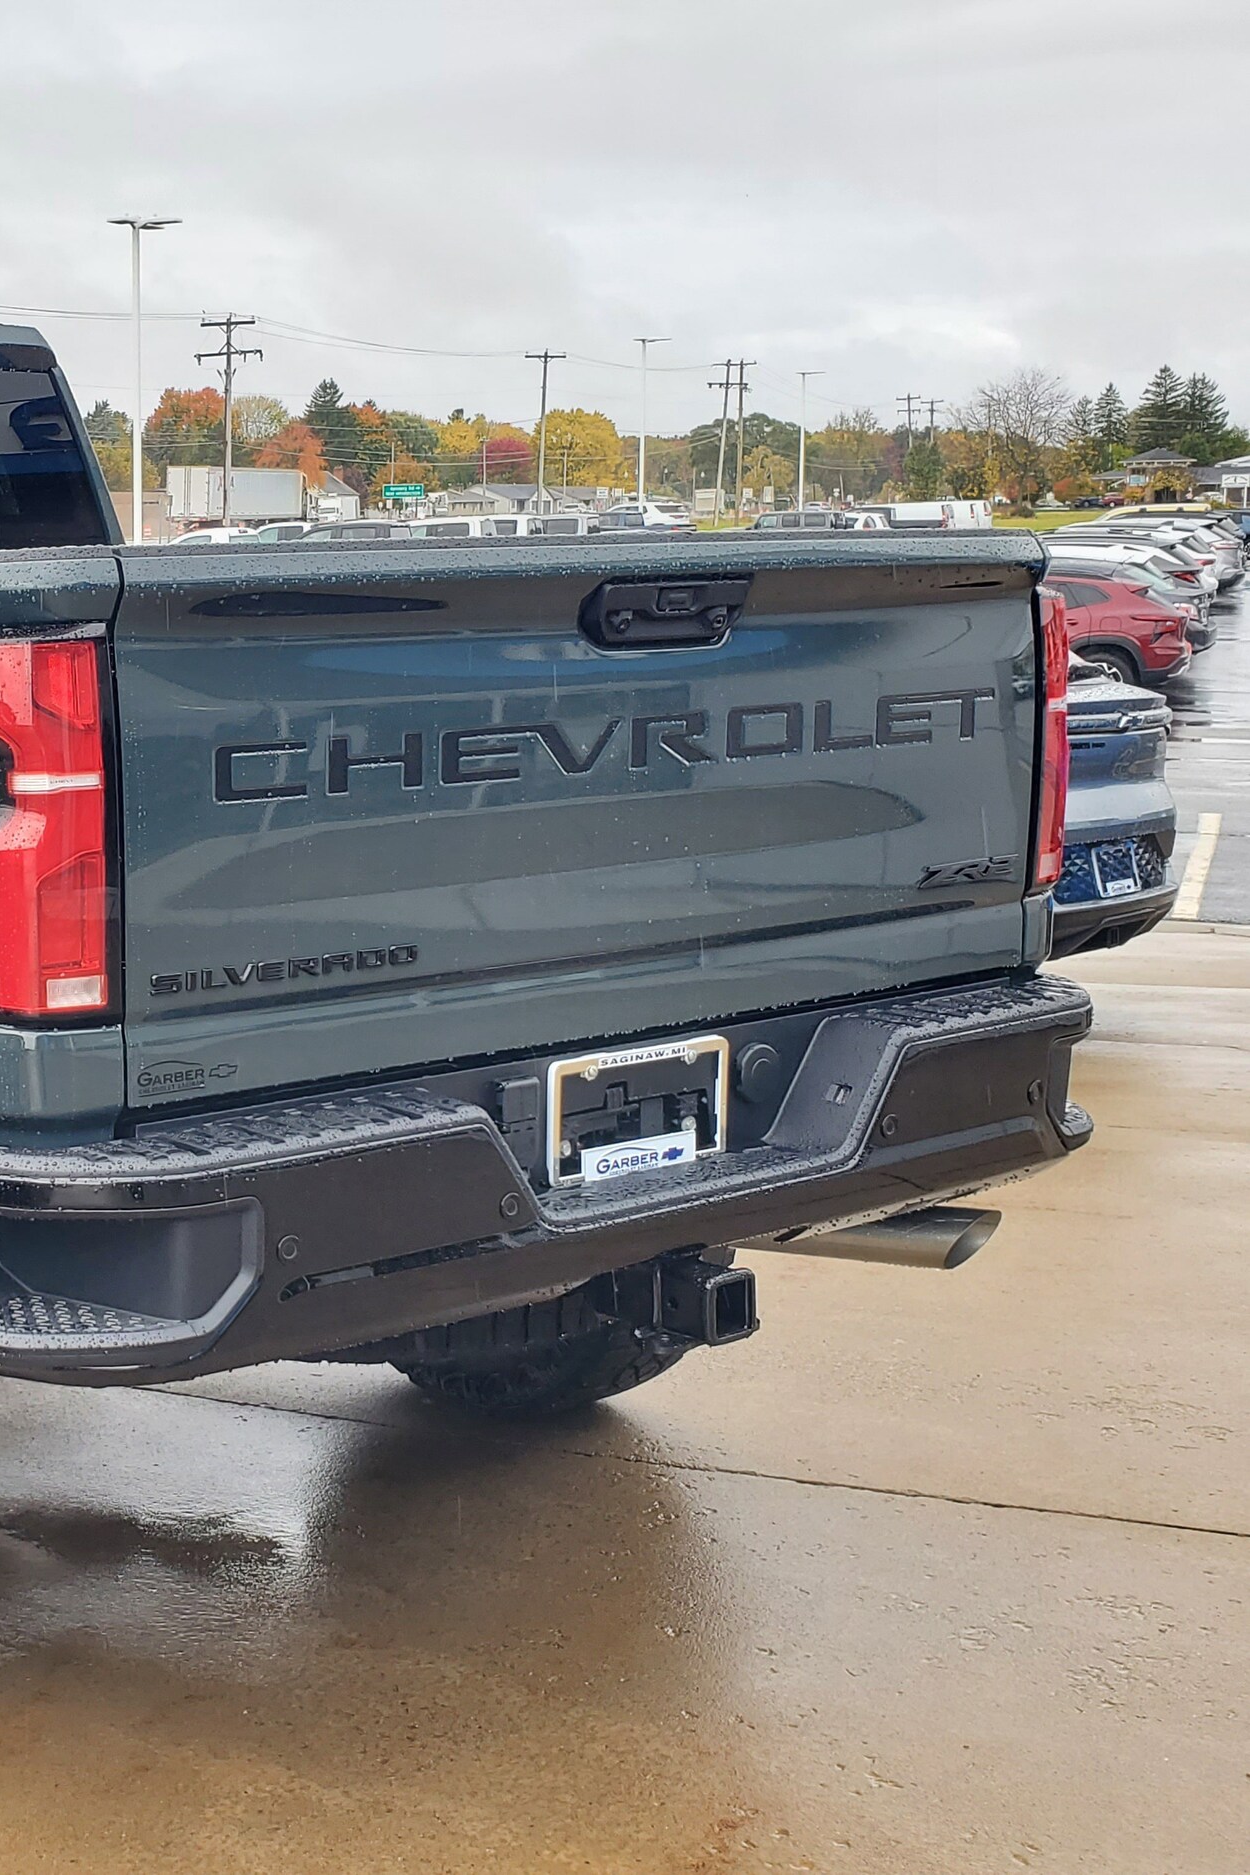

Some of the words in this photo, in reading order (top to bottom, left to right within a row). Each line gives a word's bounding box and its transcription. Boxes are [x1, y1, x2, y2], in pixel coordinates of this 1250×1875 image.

[213, 687, 995, 804] CHEVROLET
[150, 943, 418, 996] SILVERADO
[137, 1068, 205, 1087] GARBER
[596, 1151, 659, 1174] GARBER
